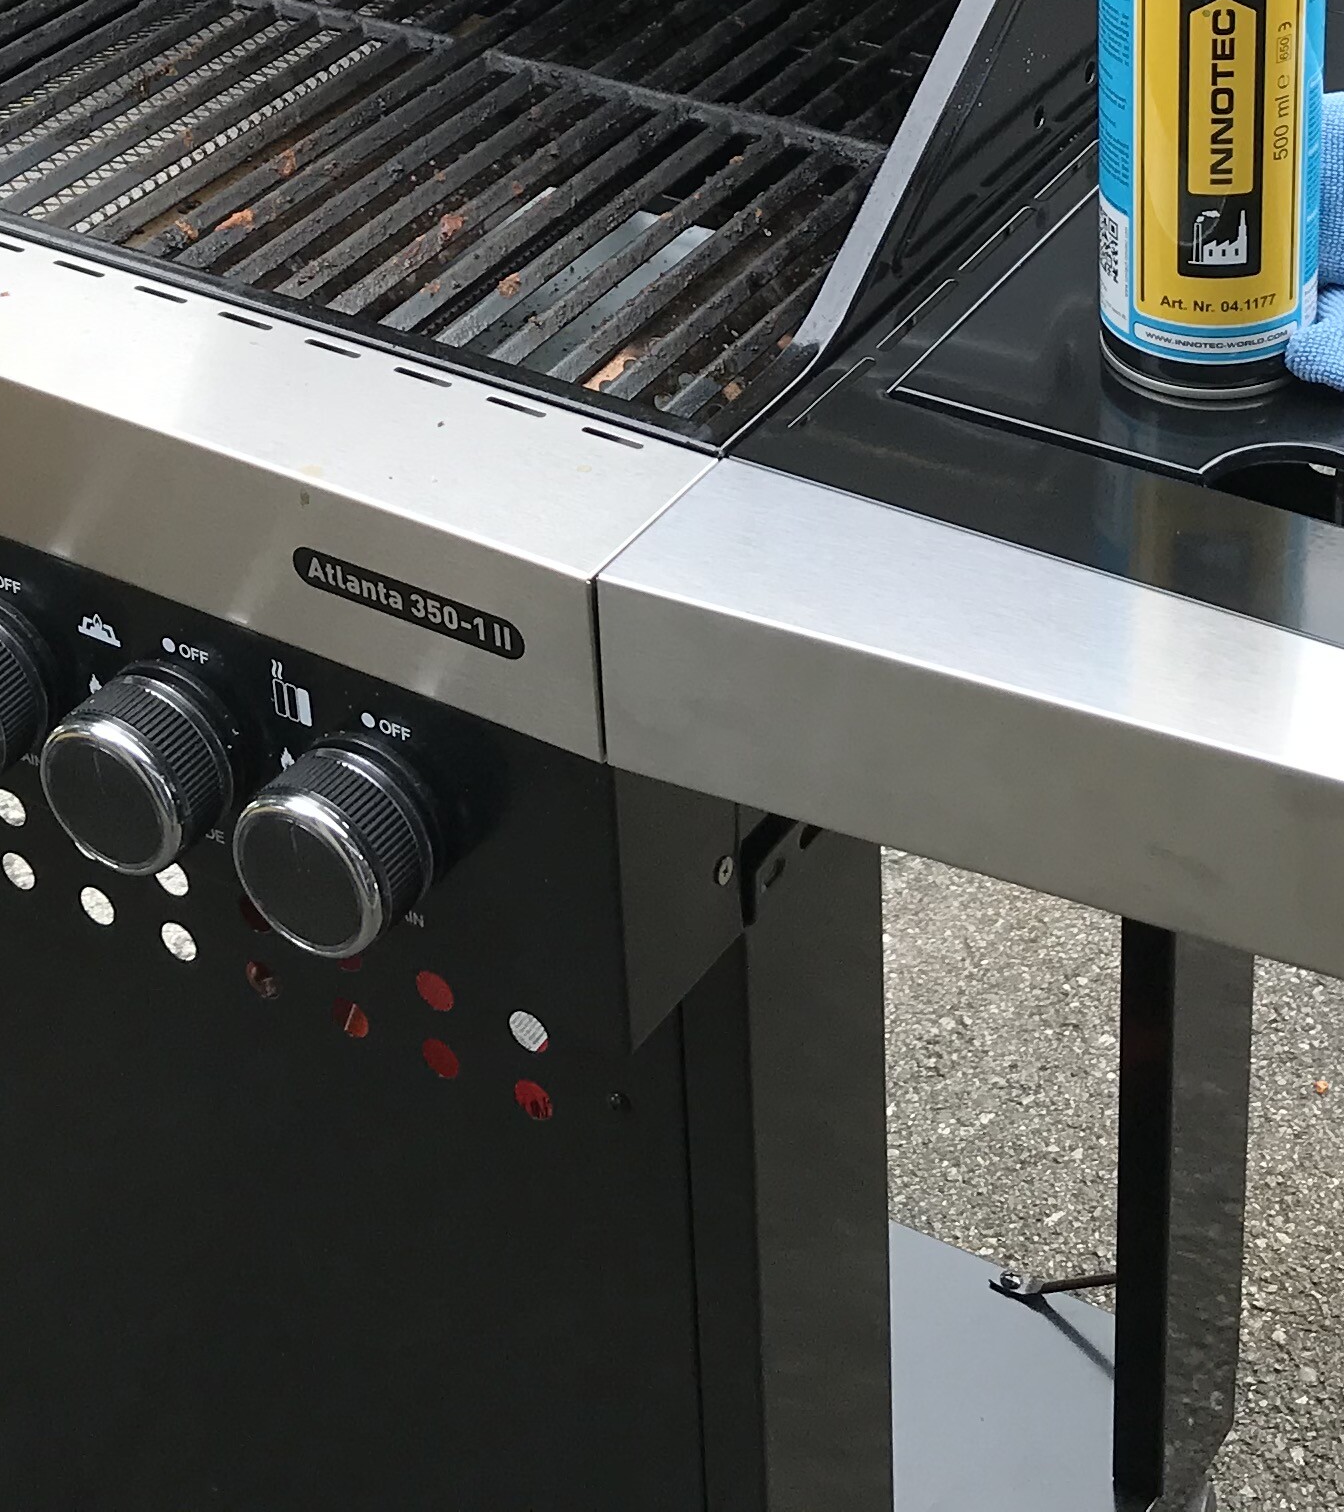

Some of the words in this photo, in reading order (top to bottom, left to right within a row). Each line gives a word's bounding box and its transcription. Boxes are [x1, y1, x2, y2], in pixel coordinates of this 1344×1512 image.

[1210, 8, 1236, 185] INNOTEC
[1275, 94, 1290, 118] ml
[1274, 124, 1290, 161] 500
[1160, 295, 1188, 311] Art.
[1193, 300, 1216, 313] Nr.
[1221, 293, 1276, 313] 04.1177
[307, 556, 404, 611] Atlanta
[409, 593, 486, 641] 350-1
[493, 623, 512, 651] II
[178, 643, 209, 664] OFF
[379, 719, 412, 741] OFF
